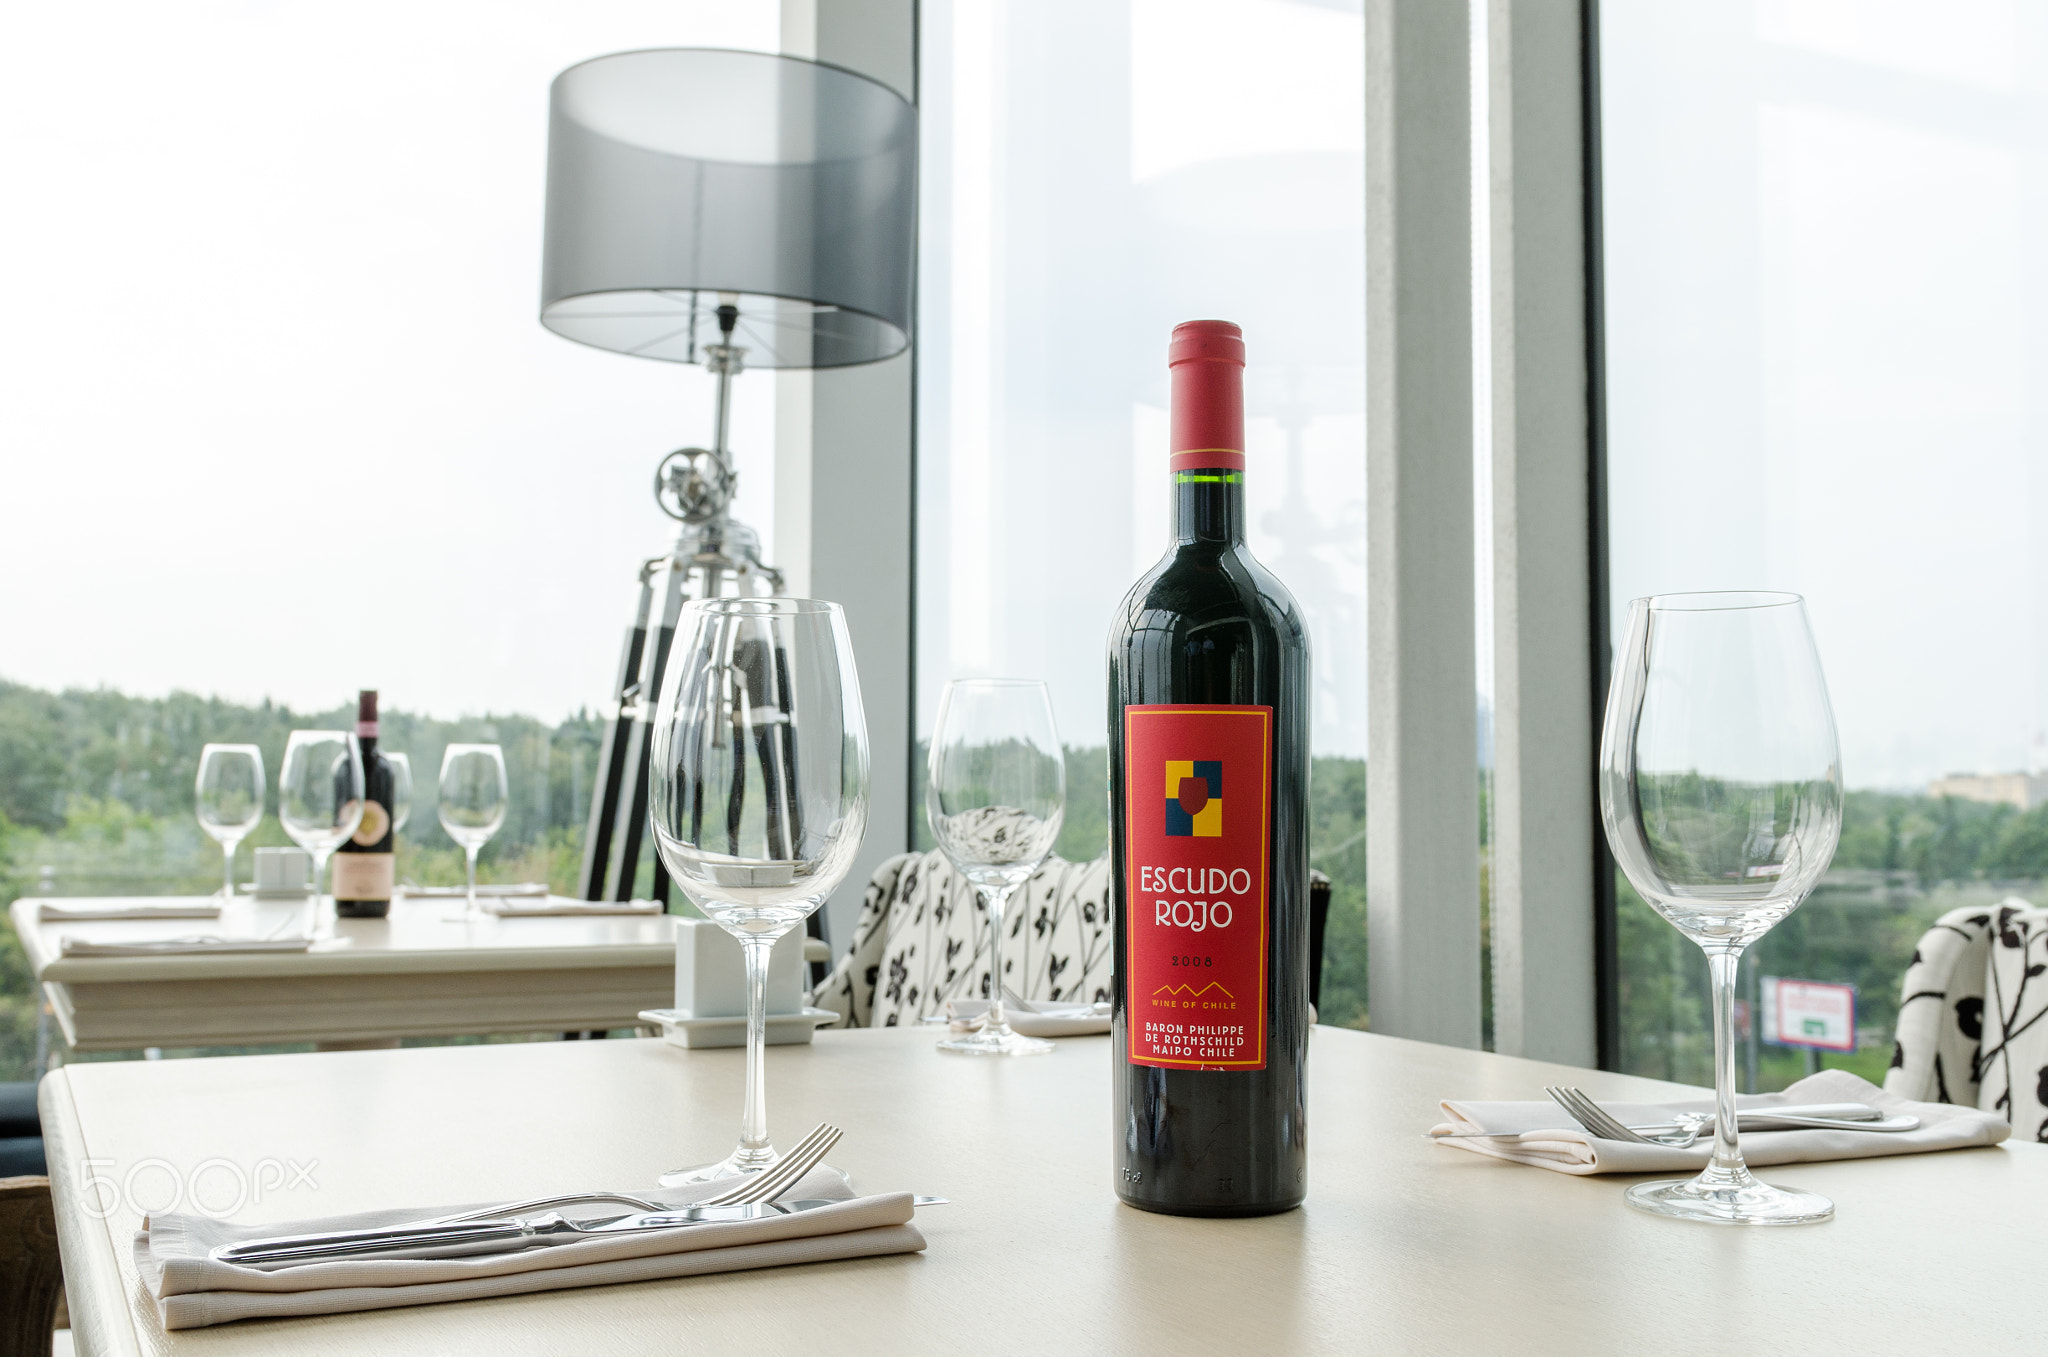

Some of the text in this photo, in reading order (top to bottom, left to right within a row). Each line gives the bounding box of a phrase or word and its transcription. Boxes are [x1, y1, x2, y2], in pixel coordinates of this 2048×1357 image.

[1141, 866, 1251, 895] ESCUDO
[1155, 900, 1233, 932] ROJO
[1172, 955, 1213, 967] 2008
[1152, 999, 1237, 1010] WINE OF CHILE
[1145, 1022, 1244, 1035] BARON PHILIPPE
[1145, 1033, 1244, 1046] DE ROTHSCHILD
[1152, 1045, 1235, 1057] MAIPO CHILE
